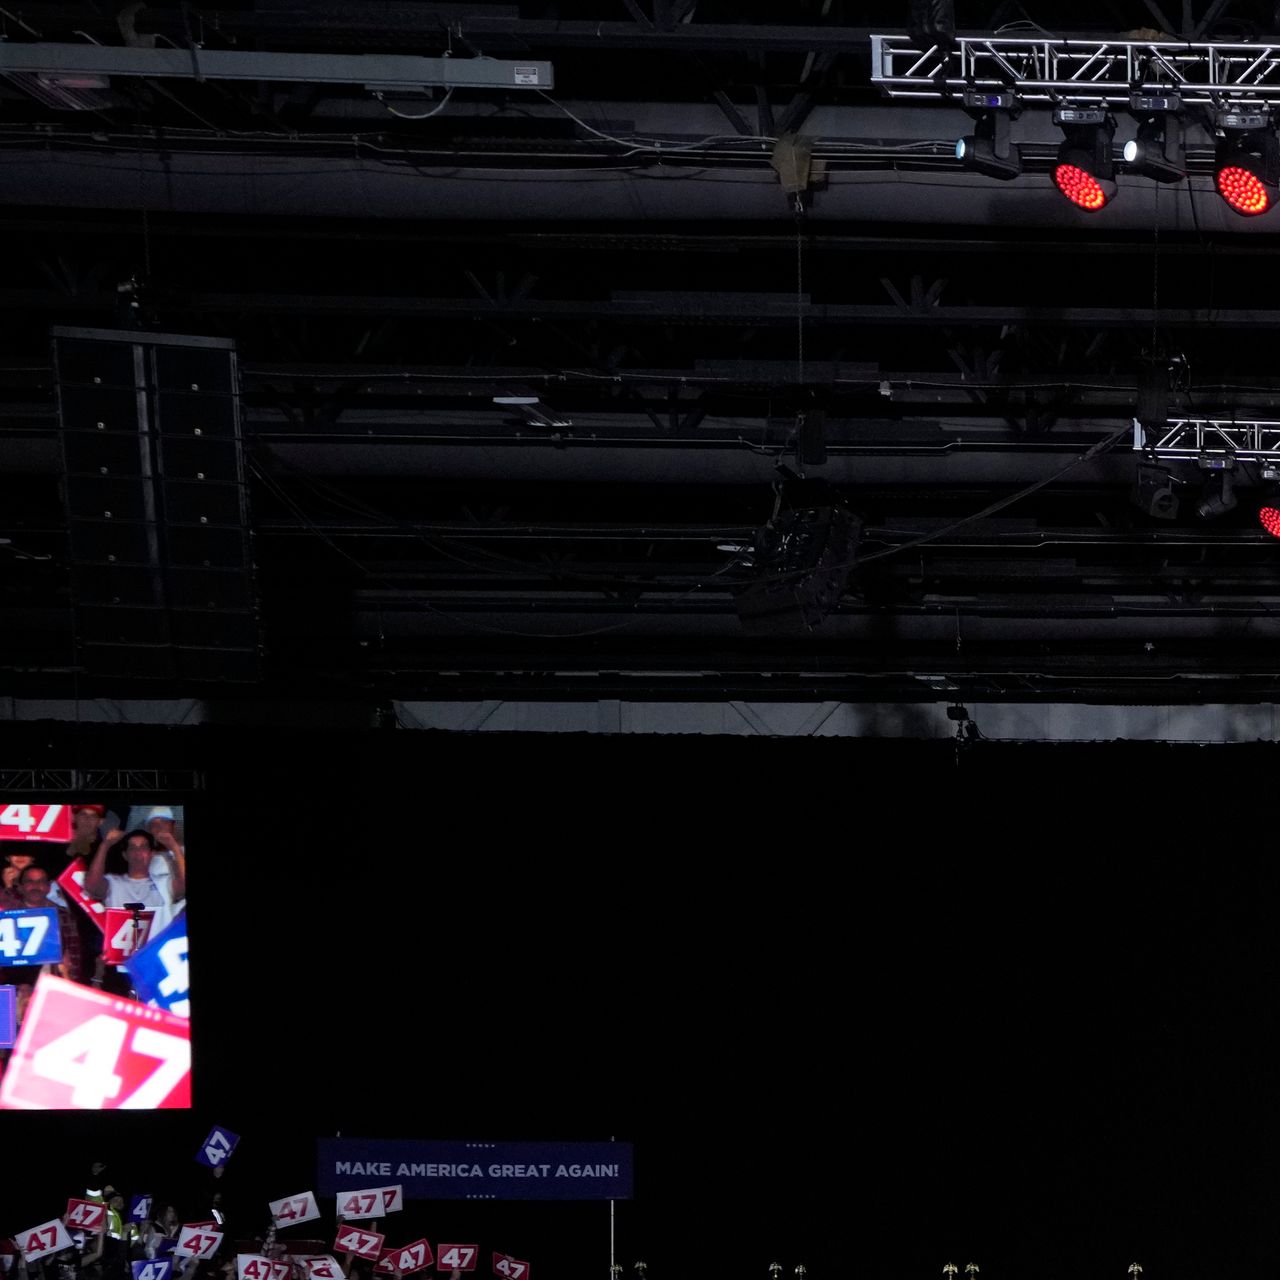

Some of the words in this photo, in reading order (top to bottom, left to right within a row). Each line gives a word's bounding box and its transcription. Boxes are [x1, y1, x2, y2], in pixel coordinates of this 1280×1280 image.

[0, 805, 62, 832] 47
[34, 1014, 191, 1109] 47
[206, 1131, 230, 1164] 47
[336, 1162, 391, 1177] MAKE
[397, 1163, 483, 1177] AMERICA
[489, 1164, 551, 1177] GREAT
[555, 1165, 618, 1178] AGAIN!
[344, 1194, 376, 1214] 47
[25, 1226, 57, 1252] 47
[340, 1232, 379, 1255] 47
[399, 1244, 424, 1269] 47
[442, 1248, 474, 1267] 47
[496, 1260, 524, 1278] 47
